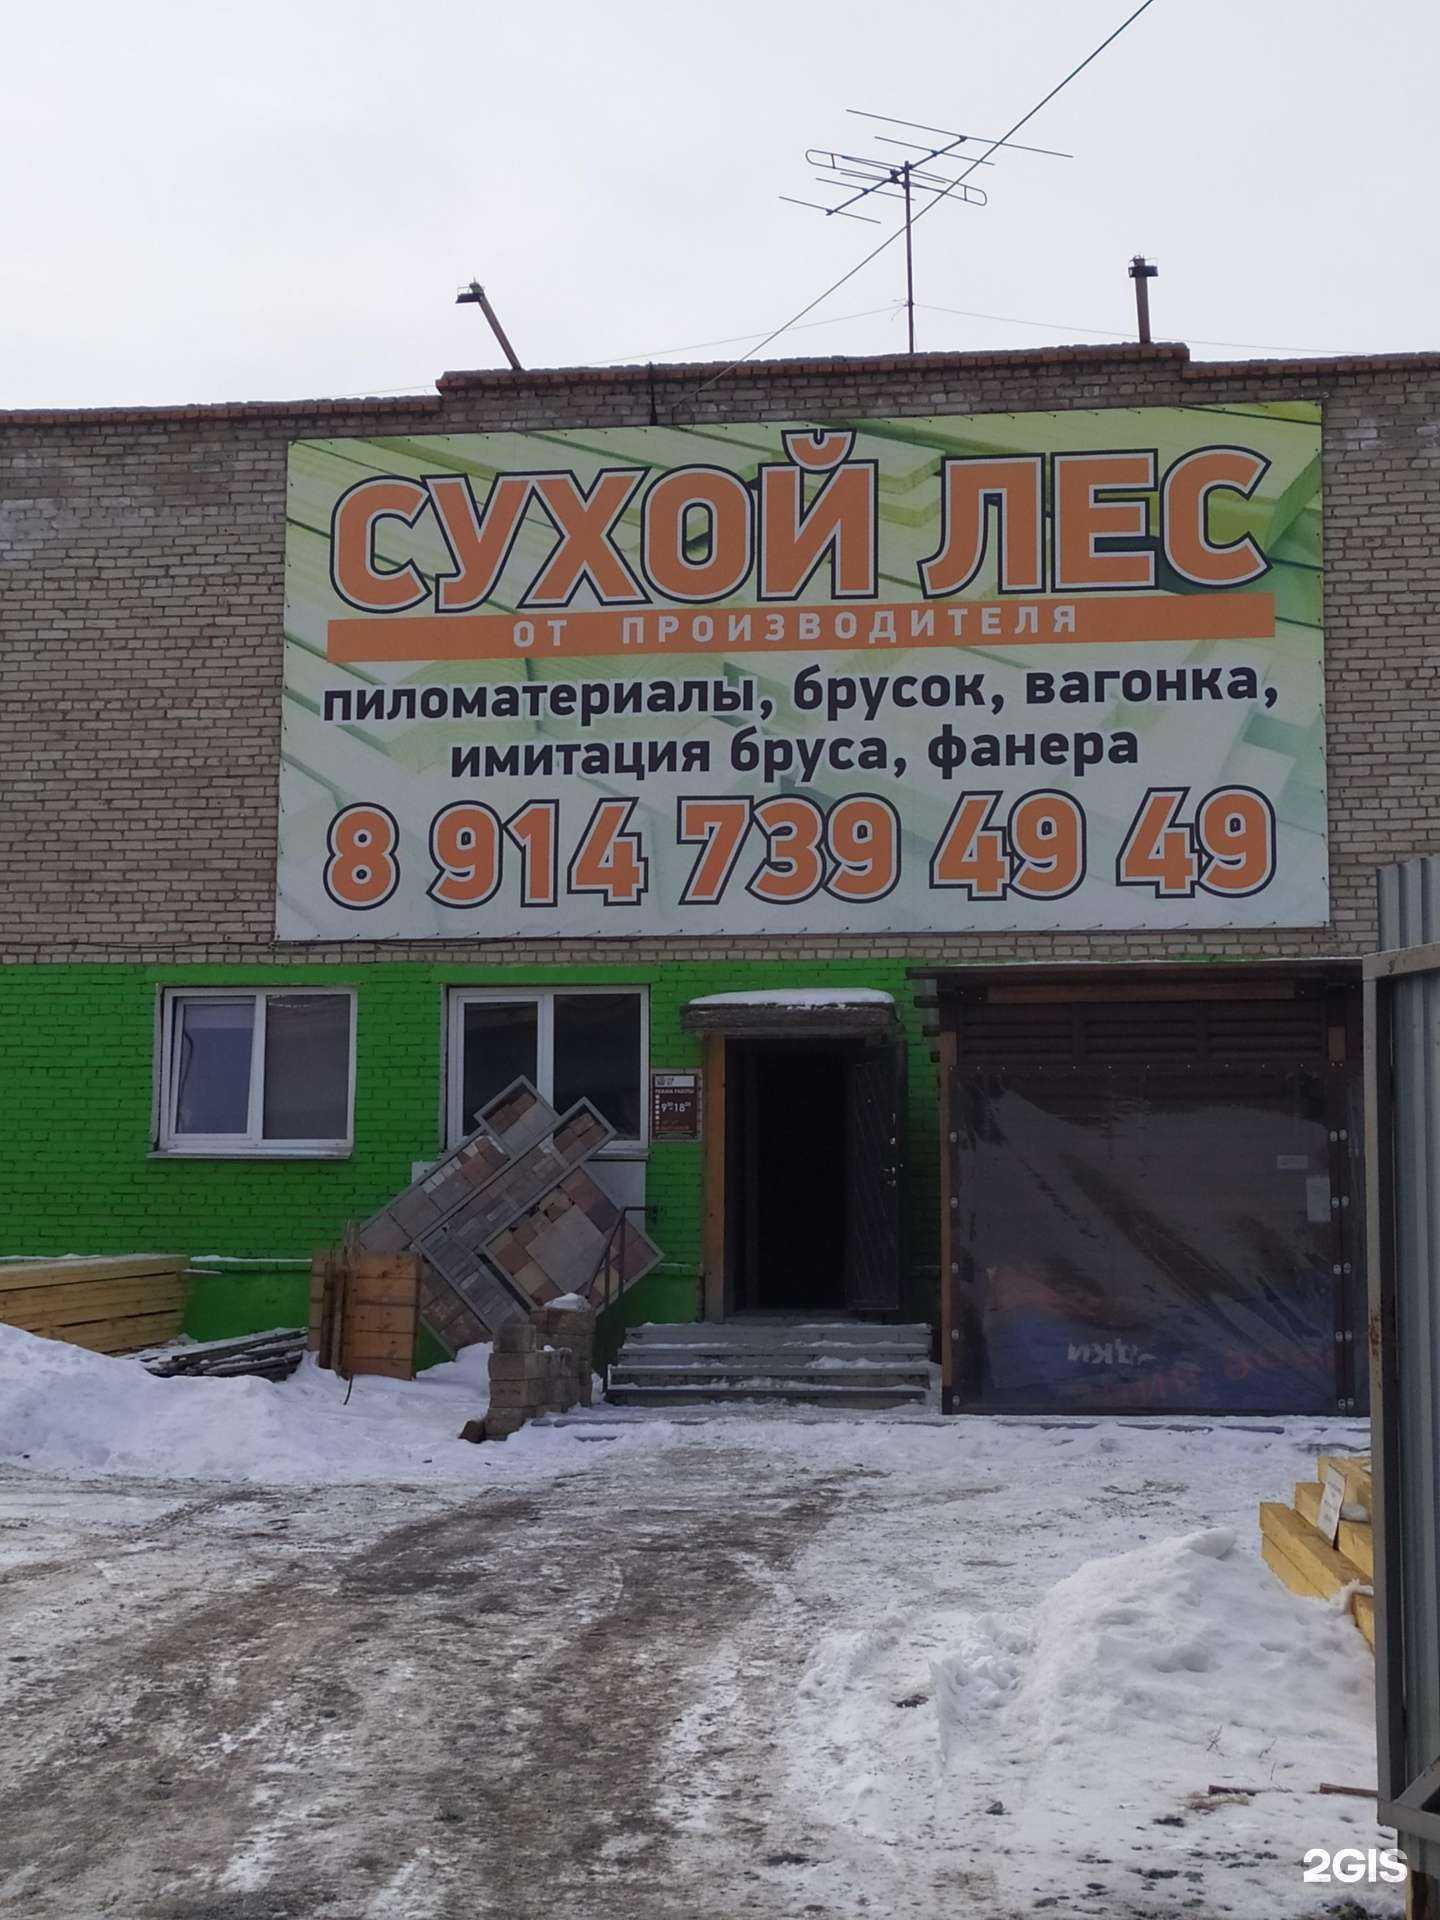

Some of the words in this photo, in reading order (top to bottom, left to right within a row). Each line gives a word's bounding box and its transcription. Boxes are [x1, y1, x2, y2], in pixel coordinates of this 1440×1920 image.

[329, 428, 879, 614] СУХОЙ
[917, 444, 1273, 600] ЛЕС
[512, 619, 569, 647] ОТ
[622, 605, 1077, 645] ПРОИЗВОДИТЕЛЯ
[323, 678, 774, 727] пиломатериалы,
[794, 664, 1005, 722] брусок,
[1025, 665, 1278, 709] вагонка,
[451, 740, 711, 781] имитация
[730, 725, 907, 784] бруса,
[927, 724, 1139, 780] фанера
[322, 802, 400, 911] 8
[426, 797, 649, 910] 914
[676, 792, 901, 906] 739
[929, 787, 1088, 901] 49
[1115, 785, 1277, 900] 49
